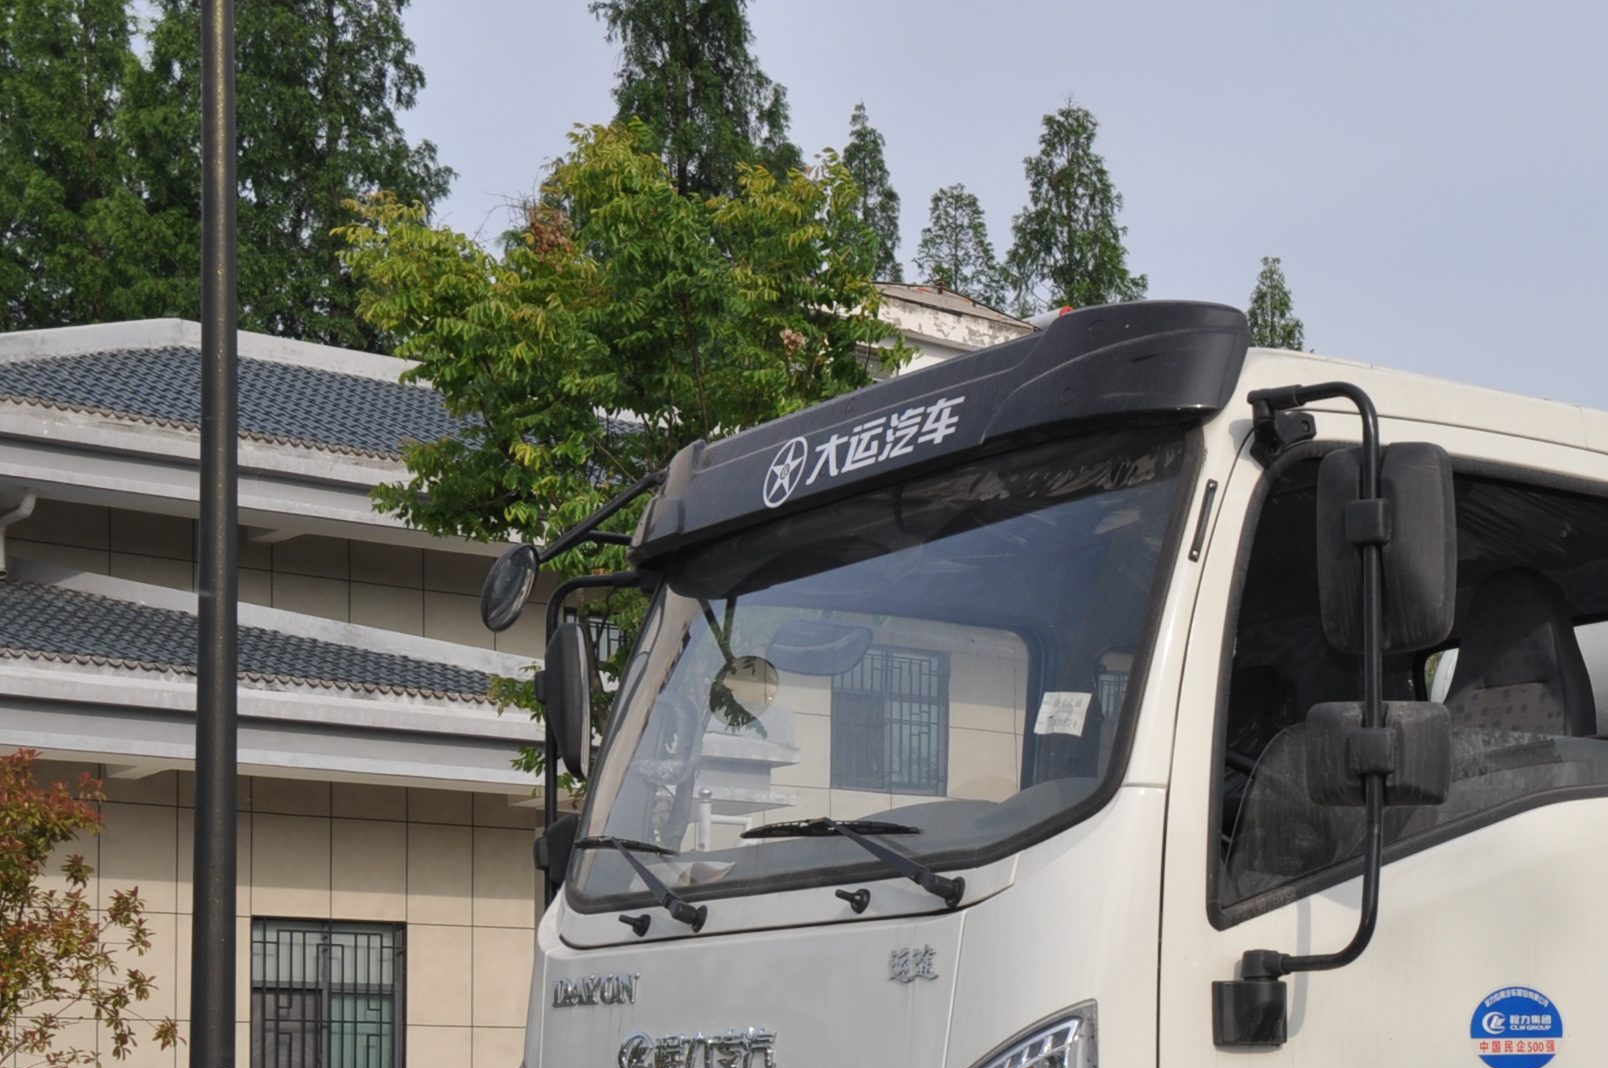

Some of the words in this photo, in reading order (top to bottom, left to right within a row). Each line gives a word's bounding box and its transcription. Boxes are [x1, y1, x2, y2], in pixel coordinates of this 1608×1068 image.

[806, 396, 965, 485] 大运汽车
[1509, 1014, 1552, 1025] 程力集团
[1479, 1039, 1555, 1053] 中国民企500强
